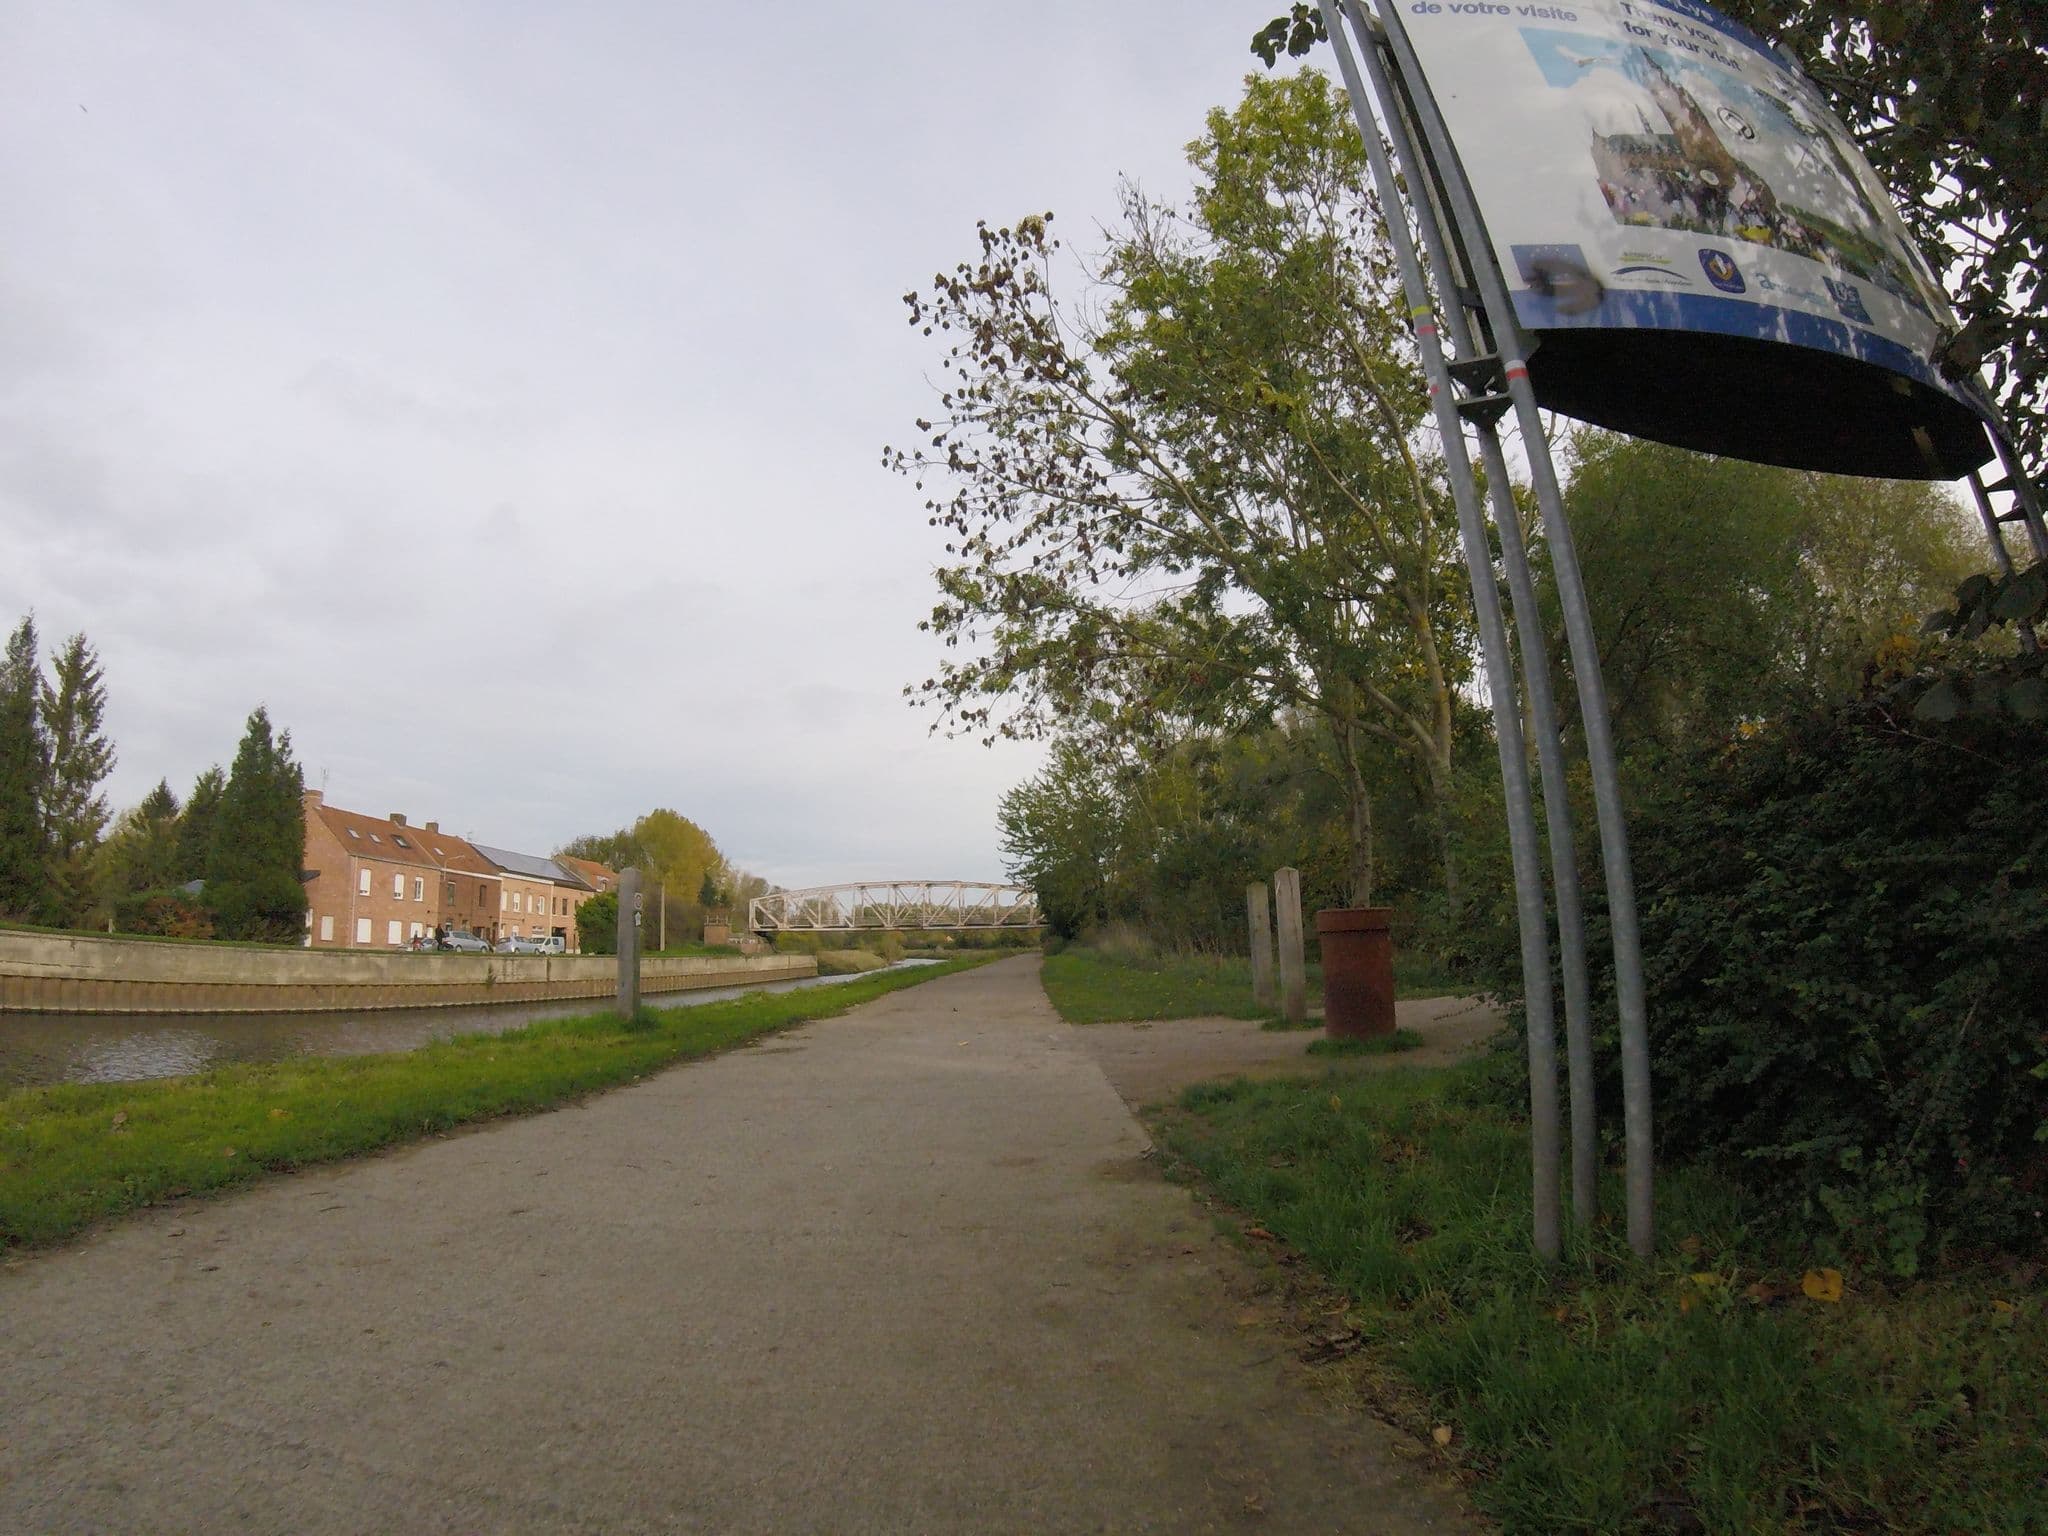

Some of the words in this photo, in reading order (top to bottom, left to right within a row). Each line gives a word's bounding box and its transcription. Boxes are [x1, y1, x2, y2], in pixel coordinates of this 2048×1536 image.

[1411, 1, 1442, 14] de
[1449, 2, 1511, 15] votre
[1516, 5, 1578, 22] visite
[1623, 20, 1653, 38] for
[1659, 33, 1700, 53] your
[1703, 48, 1742, 72] visit
[1684, 25, 1719, 46] you
